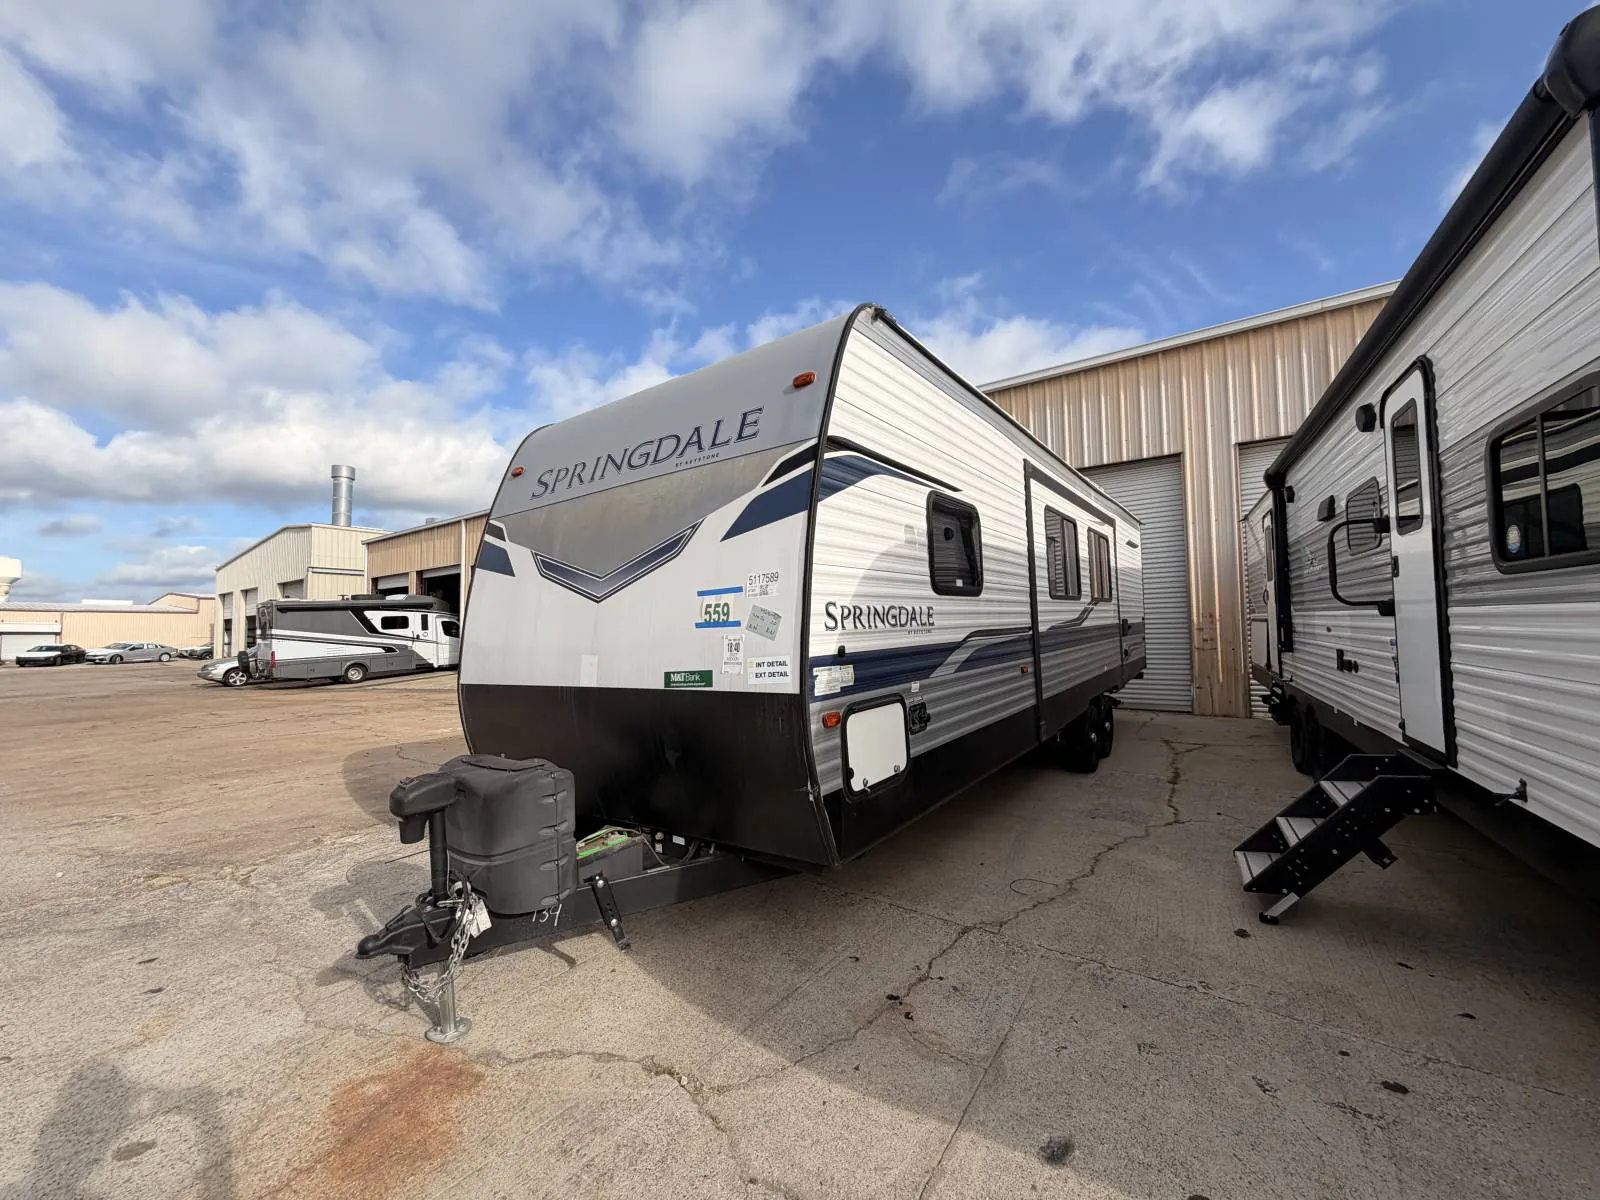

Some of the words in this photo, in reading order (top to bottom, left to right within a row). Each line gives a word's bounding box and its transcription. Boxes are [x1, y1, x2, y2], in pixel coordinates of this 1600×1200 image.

[531, 405, 764, 500] SPRINGDALE
[748, 571, 779, 586] 5117589
[703, 602, 731, 622] 559
[824, 601, 936, 631] SPRINGDALE
[767, 660, 789, 668] DETAIL
[670, 672, 685, 682] M&T
[686, 672, 701, 682] Bank
[755, 671, 766, 679] EXT
[532, 903, 563, 927] 134
